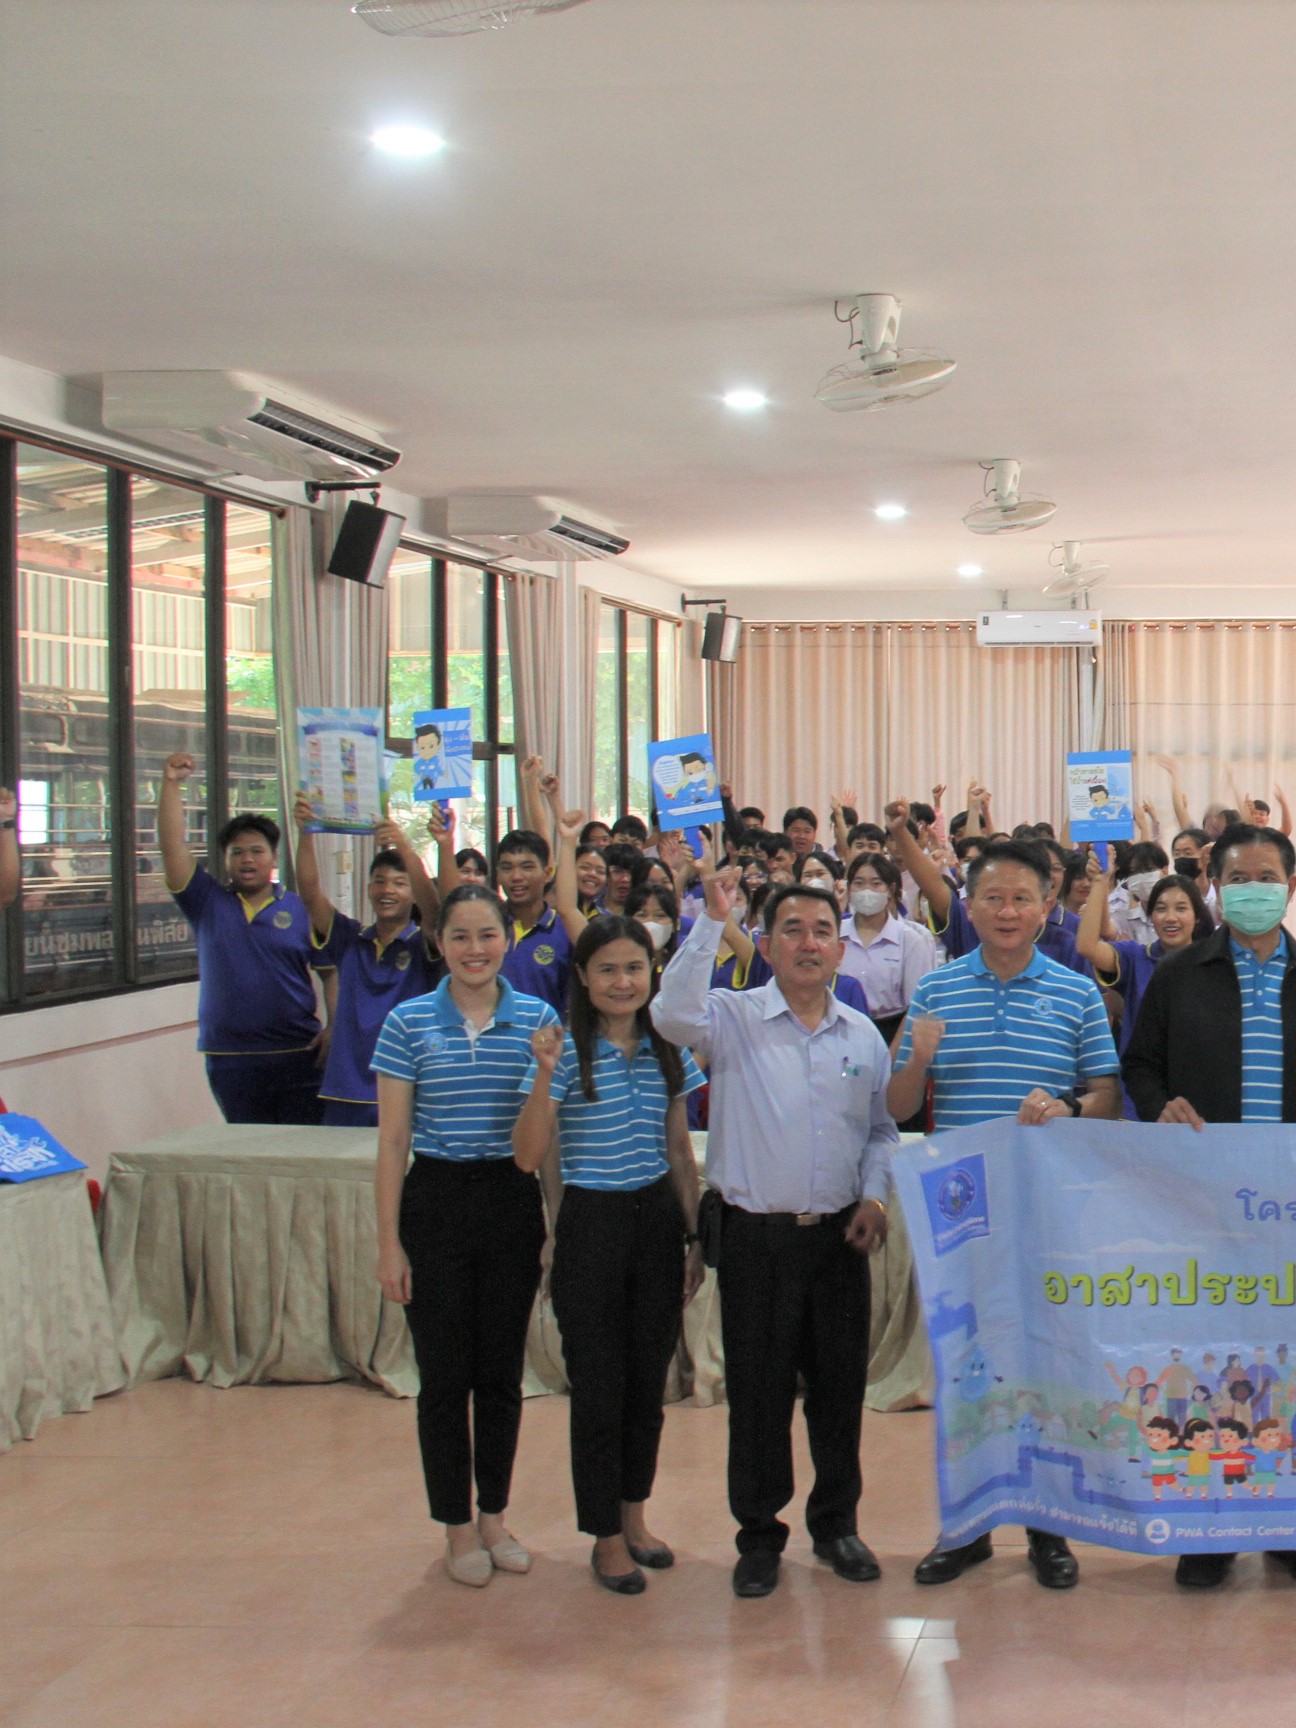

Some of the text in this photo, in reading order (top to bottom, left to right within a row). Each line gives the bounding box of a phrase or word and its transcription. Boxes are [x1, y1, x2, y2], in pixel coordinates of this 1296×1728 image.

[1176, 1526, 1204, 1538] PWA
[1208, 1525, 1253, 1538] Contact
[1257, 1524, 1296, 1536] Center
